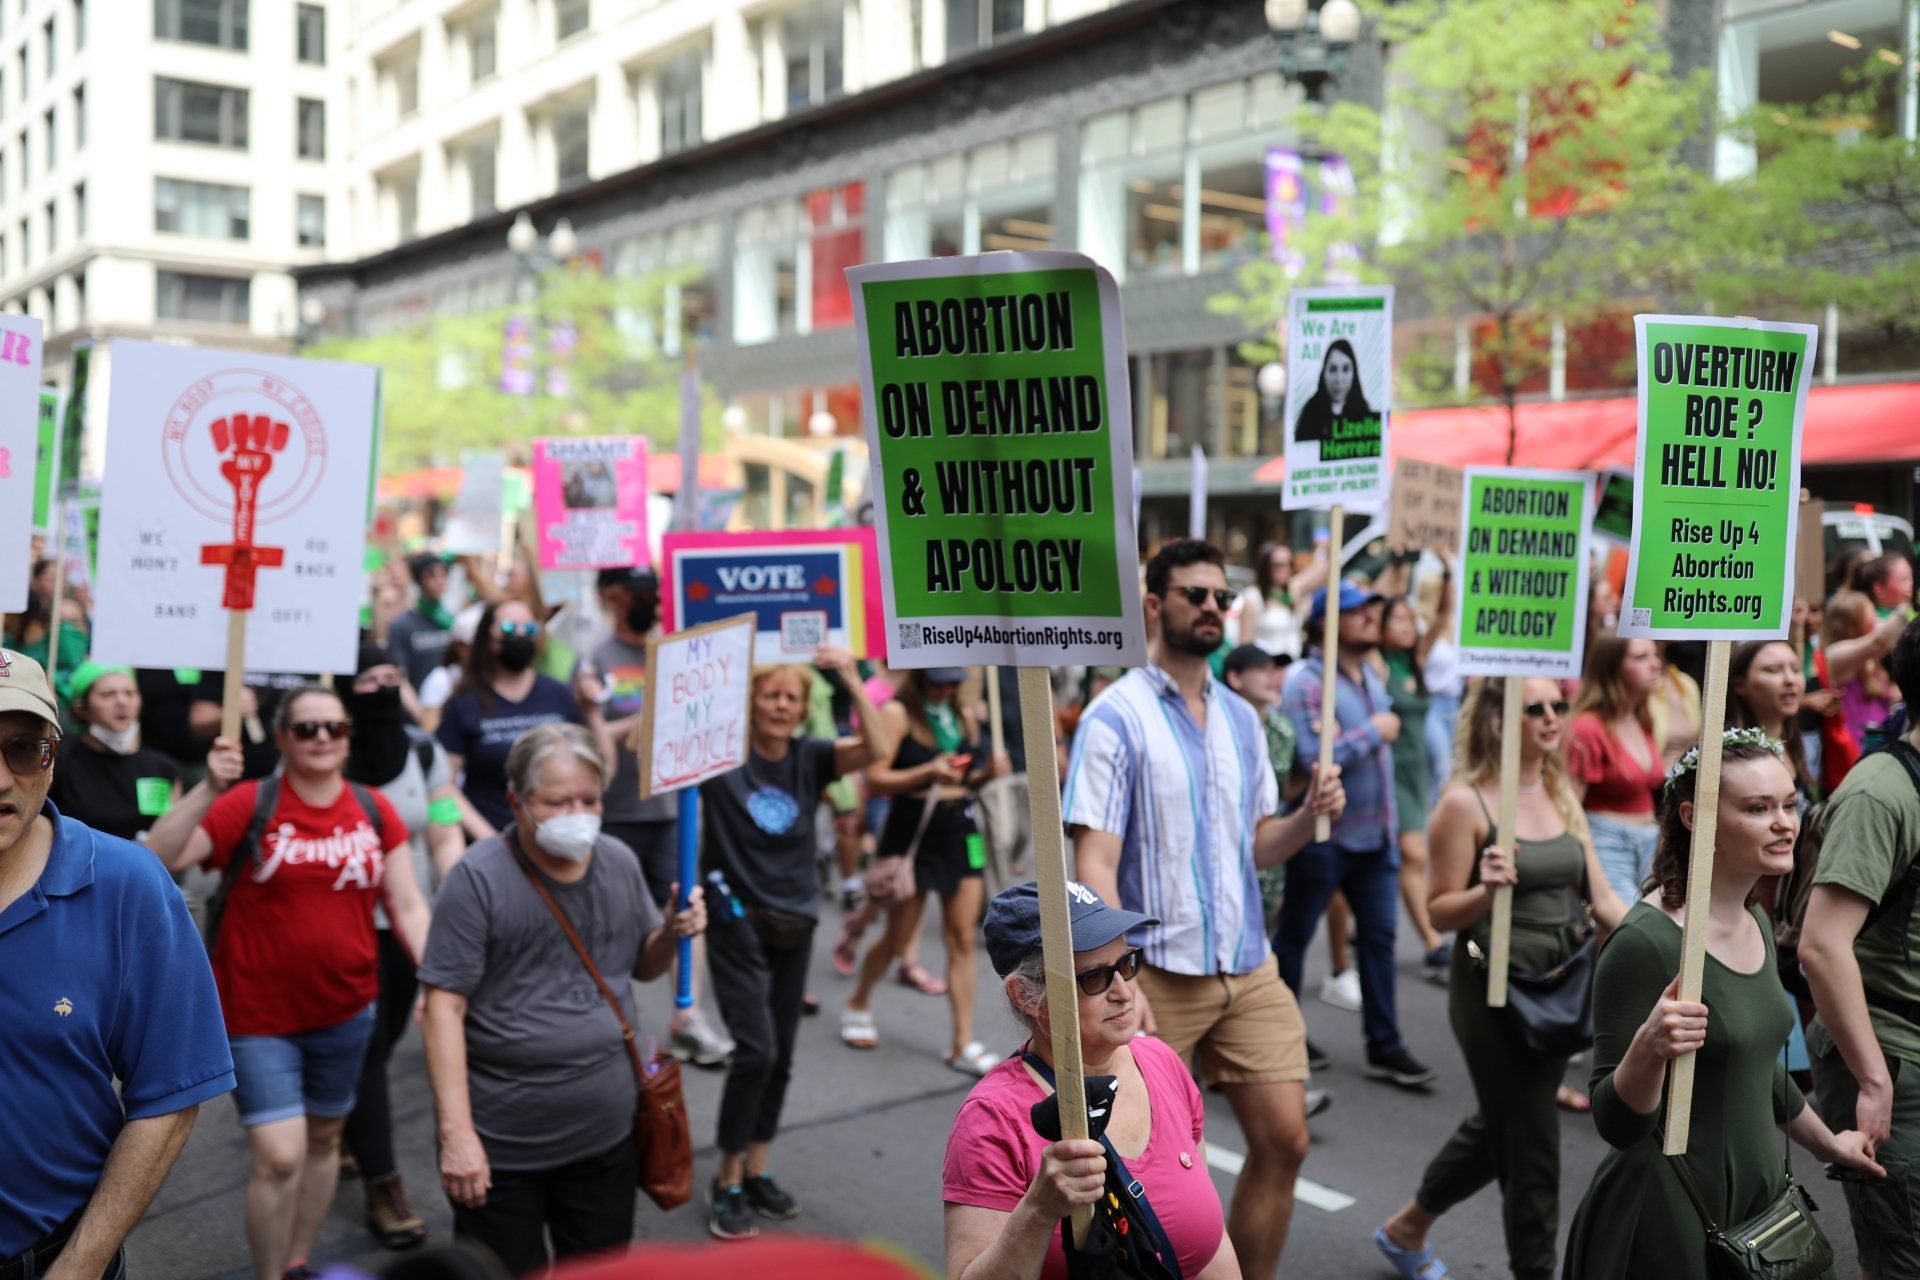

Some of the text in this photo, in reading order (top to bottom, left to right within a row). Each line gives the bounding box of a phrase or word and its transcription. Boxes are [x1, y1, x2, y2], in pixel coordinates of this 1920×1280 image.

[894, 291, 1075, 358] ABORTION
[1301, 318, 1357, 336] We Are
[1301, 343, 1321, 361] All
[1654, 342, 1798, 394] OVERTURN
[881, 375, 1102, 439] ON DEMAND
[1685, 394, 1739, 439] ROE
[1661, 444, 1777, 490] HELL NO!
[902, 458, 1096, 517] & WITHOUT
[1482, 487, 1570, 518] ABORTION
[140, 532, 164, 546] WE
[1470, 527, 1576, 558] ON DEMAND
[1671, 517, 1760, 551] Rise Up 4
[716, 564, 806, 592] VOTE
[926, 539, 1083, 594] APOLOGY
[1672, 553, 1754, 579] Abortion
[1471, 568, 1570, 598] & WITHOUT
[1664, 587, 1762, 620] Rights.org
[923, 626, 1122, 650] RiseUp4AbortionRights.org
[1476, 608, 1558, 638] APOLOGY
[687, 636, 713, 663] MY
[672, 654, 731, 704] BODY
[685, 694, 713, 731] MY
[657, 719, 738, 783] CHOICE
